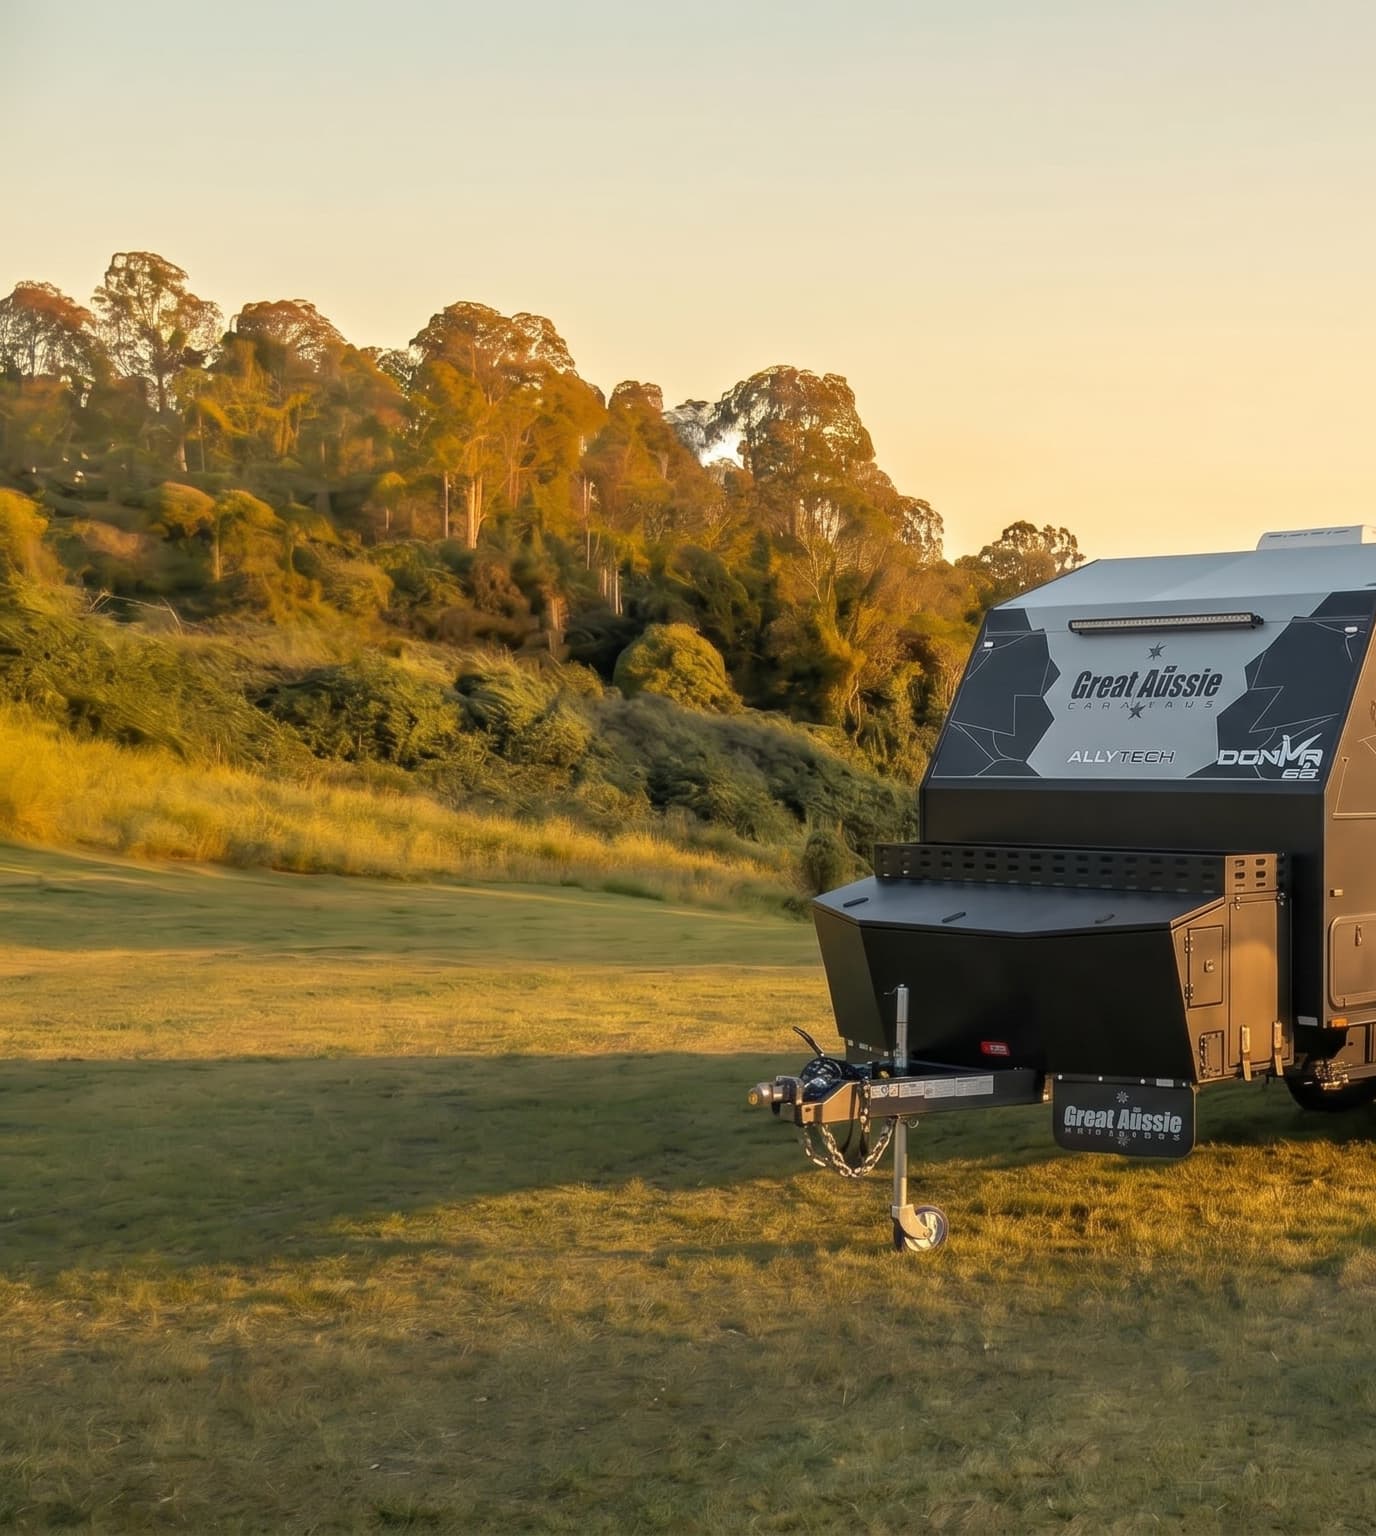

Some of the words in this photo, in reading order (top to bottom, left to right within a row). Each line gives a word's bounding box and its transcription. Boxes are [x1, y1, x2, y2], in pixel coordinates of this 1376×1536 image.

[1071, 670, 1138, 699] Great
[1067, 750, 1176, 763] ALLYTECH
[1063, 1105, 1115, 1129] Great
